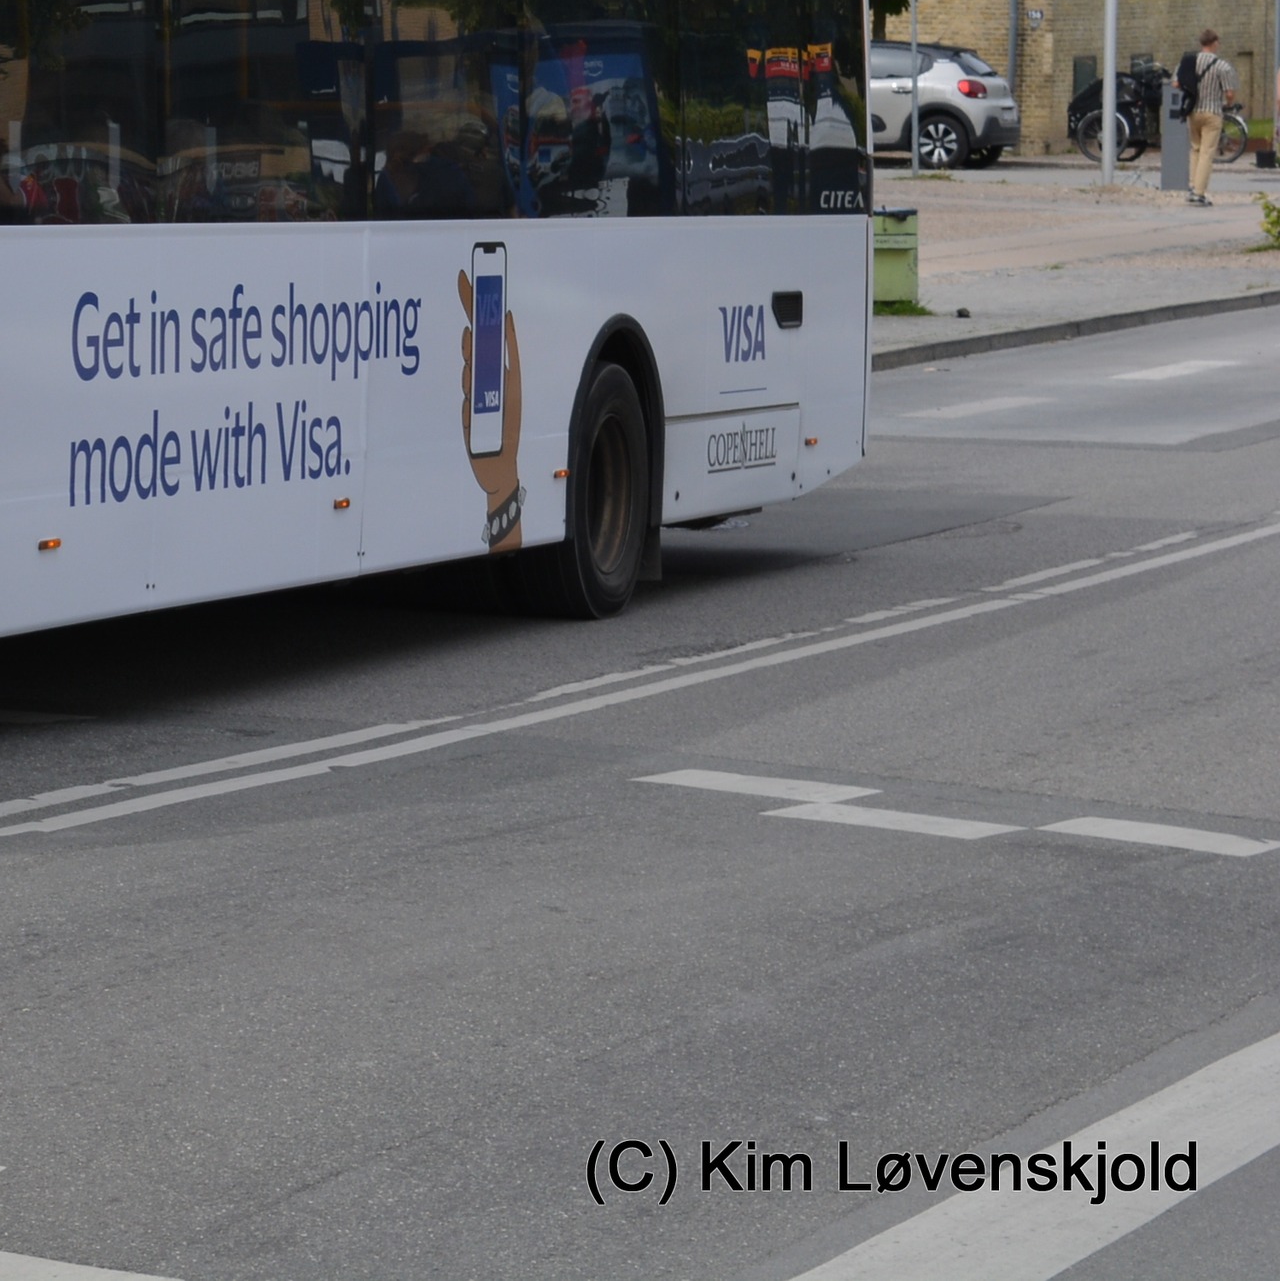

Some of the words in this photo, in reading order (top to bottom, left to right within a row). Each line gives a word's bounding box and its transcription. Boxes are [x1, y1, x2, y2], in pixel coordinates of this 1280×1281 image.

[72, 291, 141, 381] Get
[150, 290, 180, 375] in
[190, 284, 262, 372] safe
[271, 281, 422, 381] shopping
[718, 304, 766, 363] VISA
[484, 391, 499, 407] VISA
[69, 410, 181, 507] mode
[190, 402, 267, 492] with
[276, 399, 351, 482] Visa.
[707, 423, 777, 467] COPENHELL
